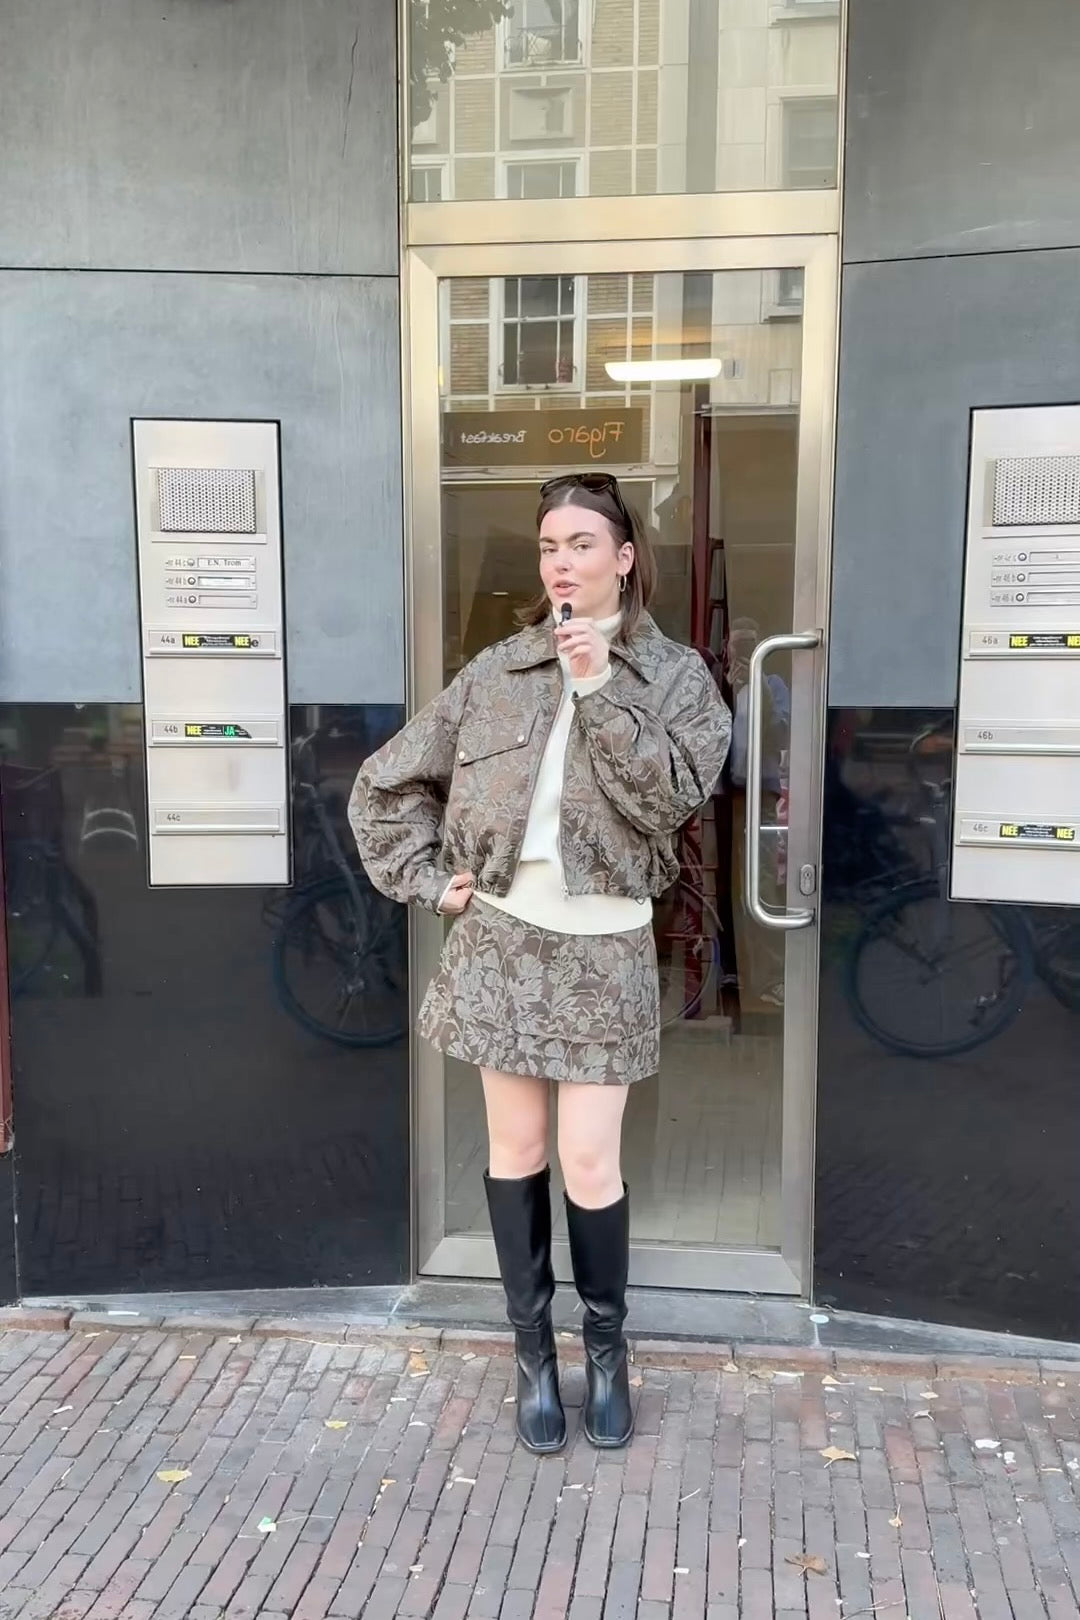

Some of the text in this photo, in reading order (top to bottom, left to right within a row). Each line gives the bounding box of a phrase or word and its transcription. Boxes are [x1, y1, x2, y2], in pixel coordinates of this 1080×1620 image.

[184, 636, 199, 646] NEE
[234, 636, 250, 646] NEE
[1011, 636, 1028, 647] NEE
[186, 725, 202, 735] NEE
[224, 725, 236, 736] JA
[1001, 825, 1019, 836] NEE
[1056, 828, 1073, 839] NEE
